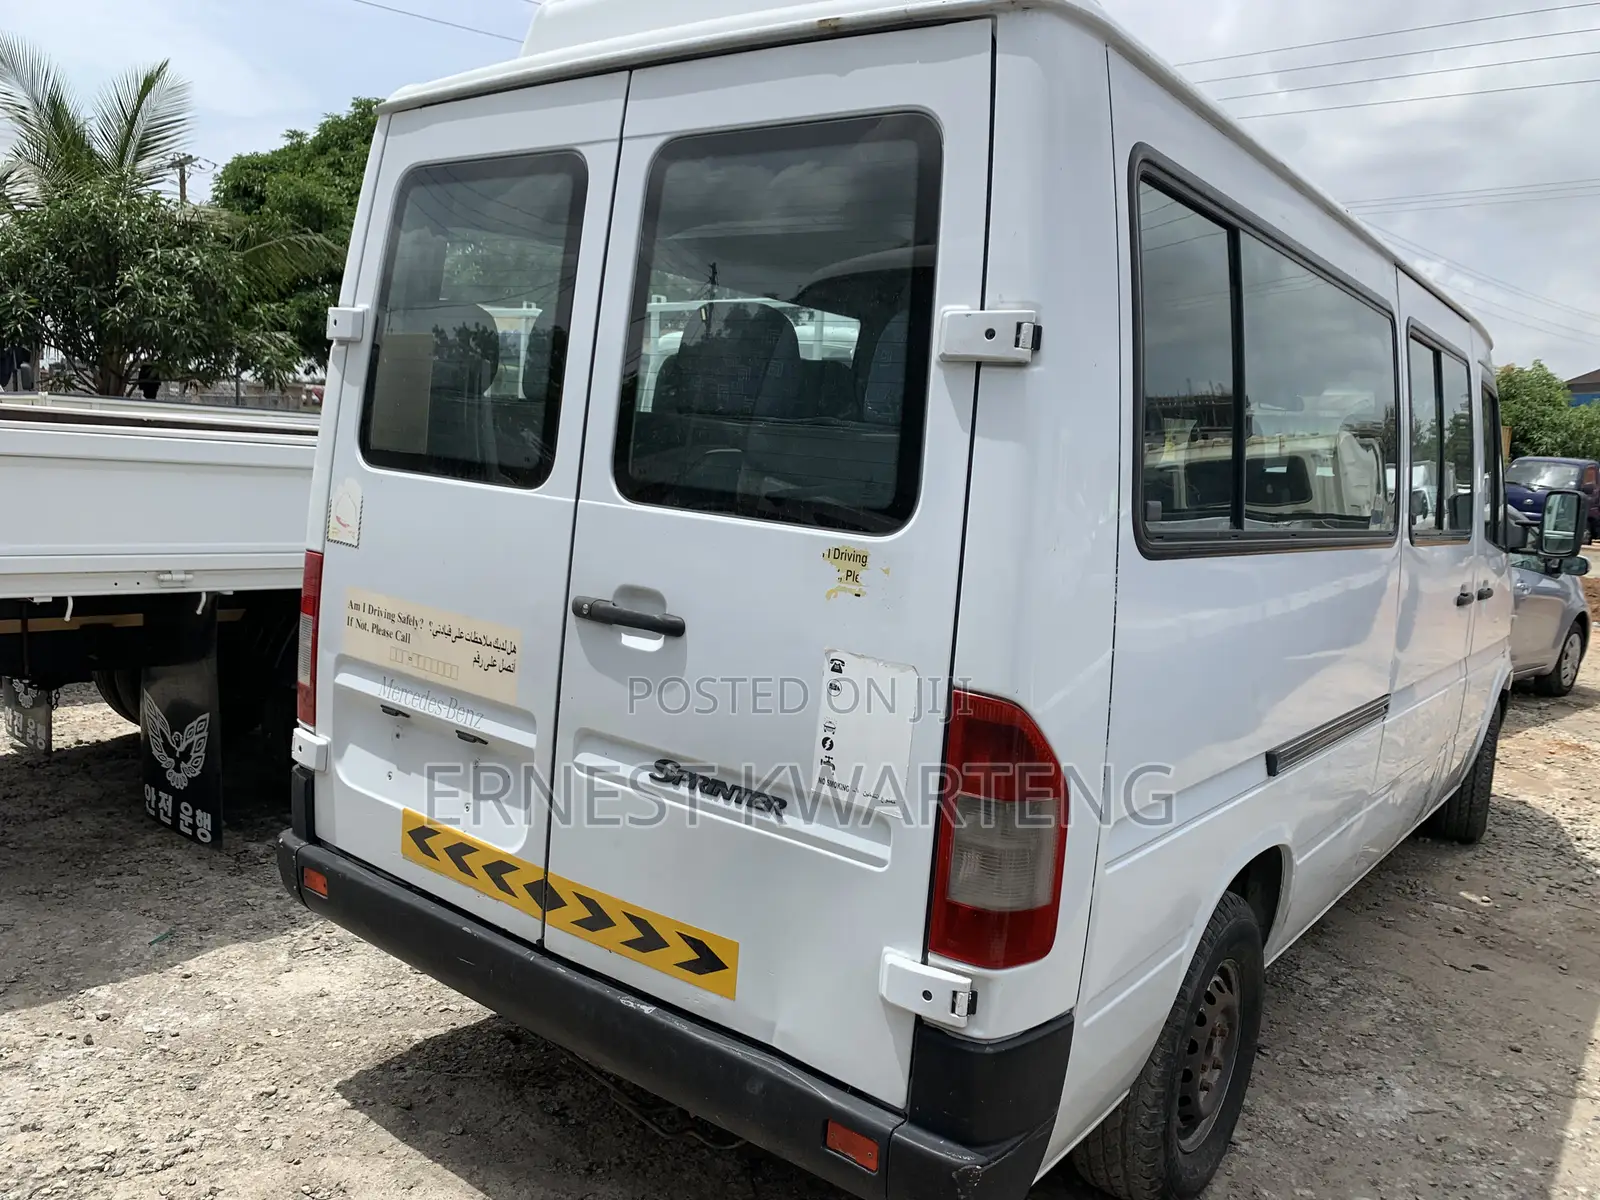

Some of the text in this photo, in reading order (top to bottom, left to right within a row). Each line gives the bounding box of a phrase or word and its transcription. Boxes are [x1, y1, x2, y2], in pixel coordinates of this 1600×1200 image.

[833, 547, 868, 567] Driving
[347, 600, 424, 630] Am I Driving Safely?
[346, 616, 354, 627] If
[371, 622, 394, 639] Please
[394, 629, 411, 645] Call
[464, 630, 492, 648] ملاحظات
[378, 676, 485, 729] Mercedes-Benz
[818, 776, 826, 786] NO
[826, 779, 850, 793] SMOKING
[144, 783, 212, 843] 안전 운행
